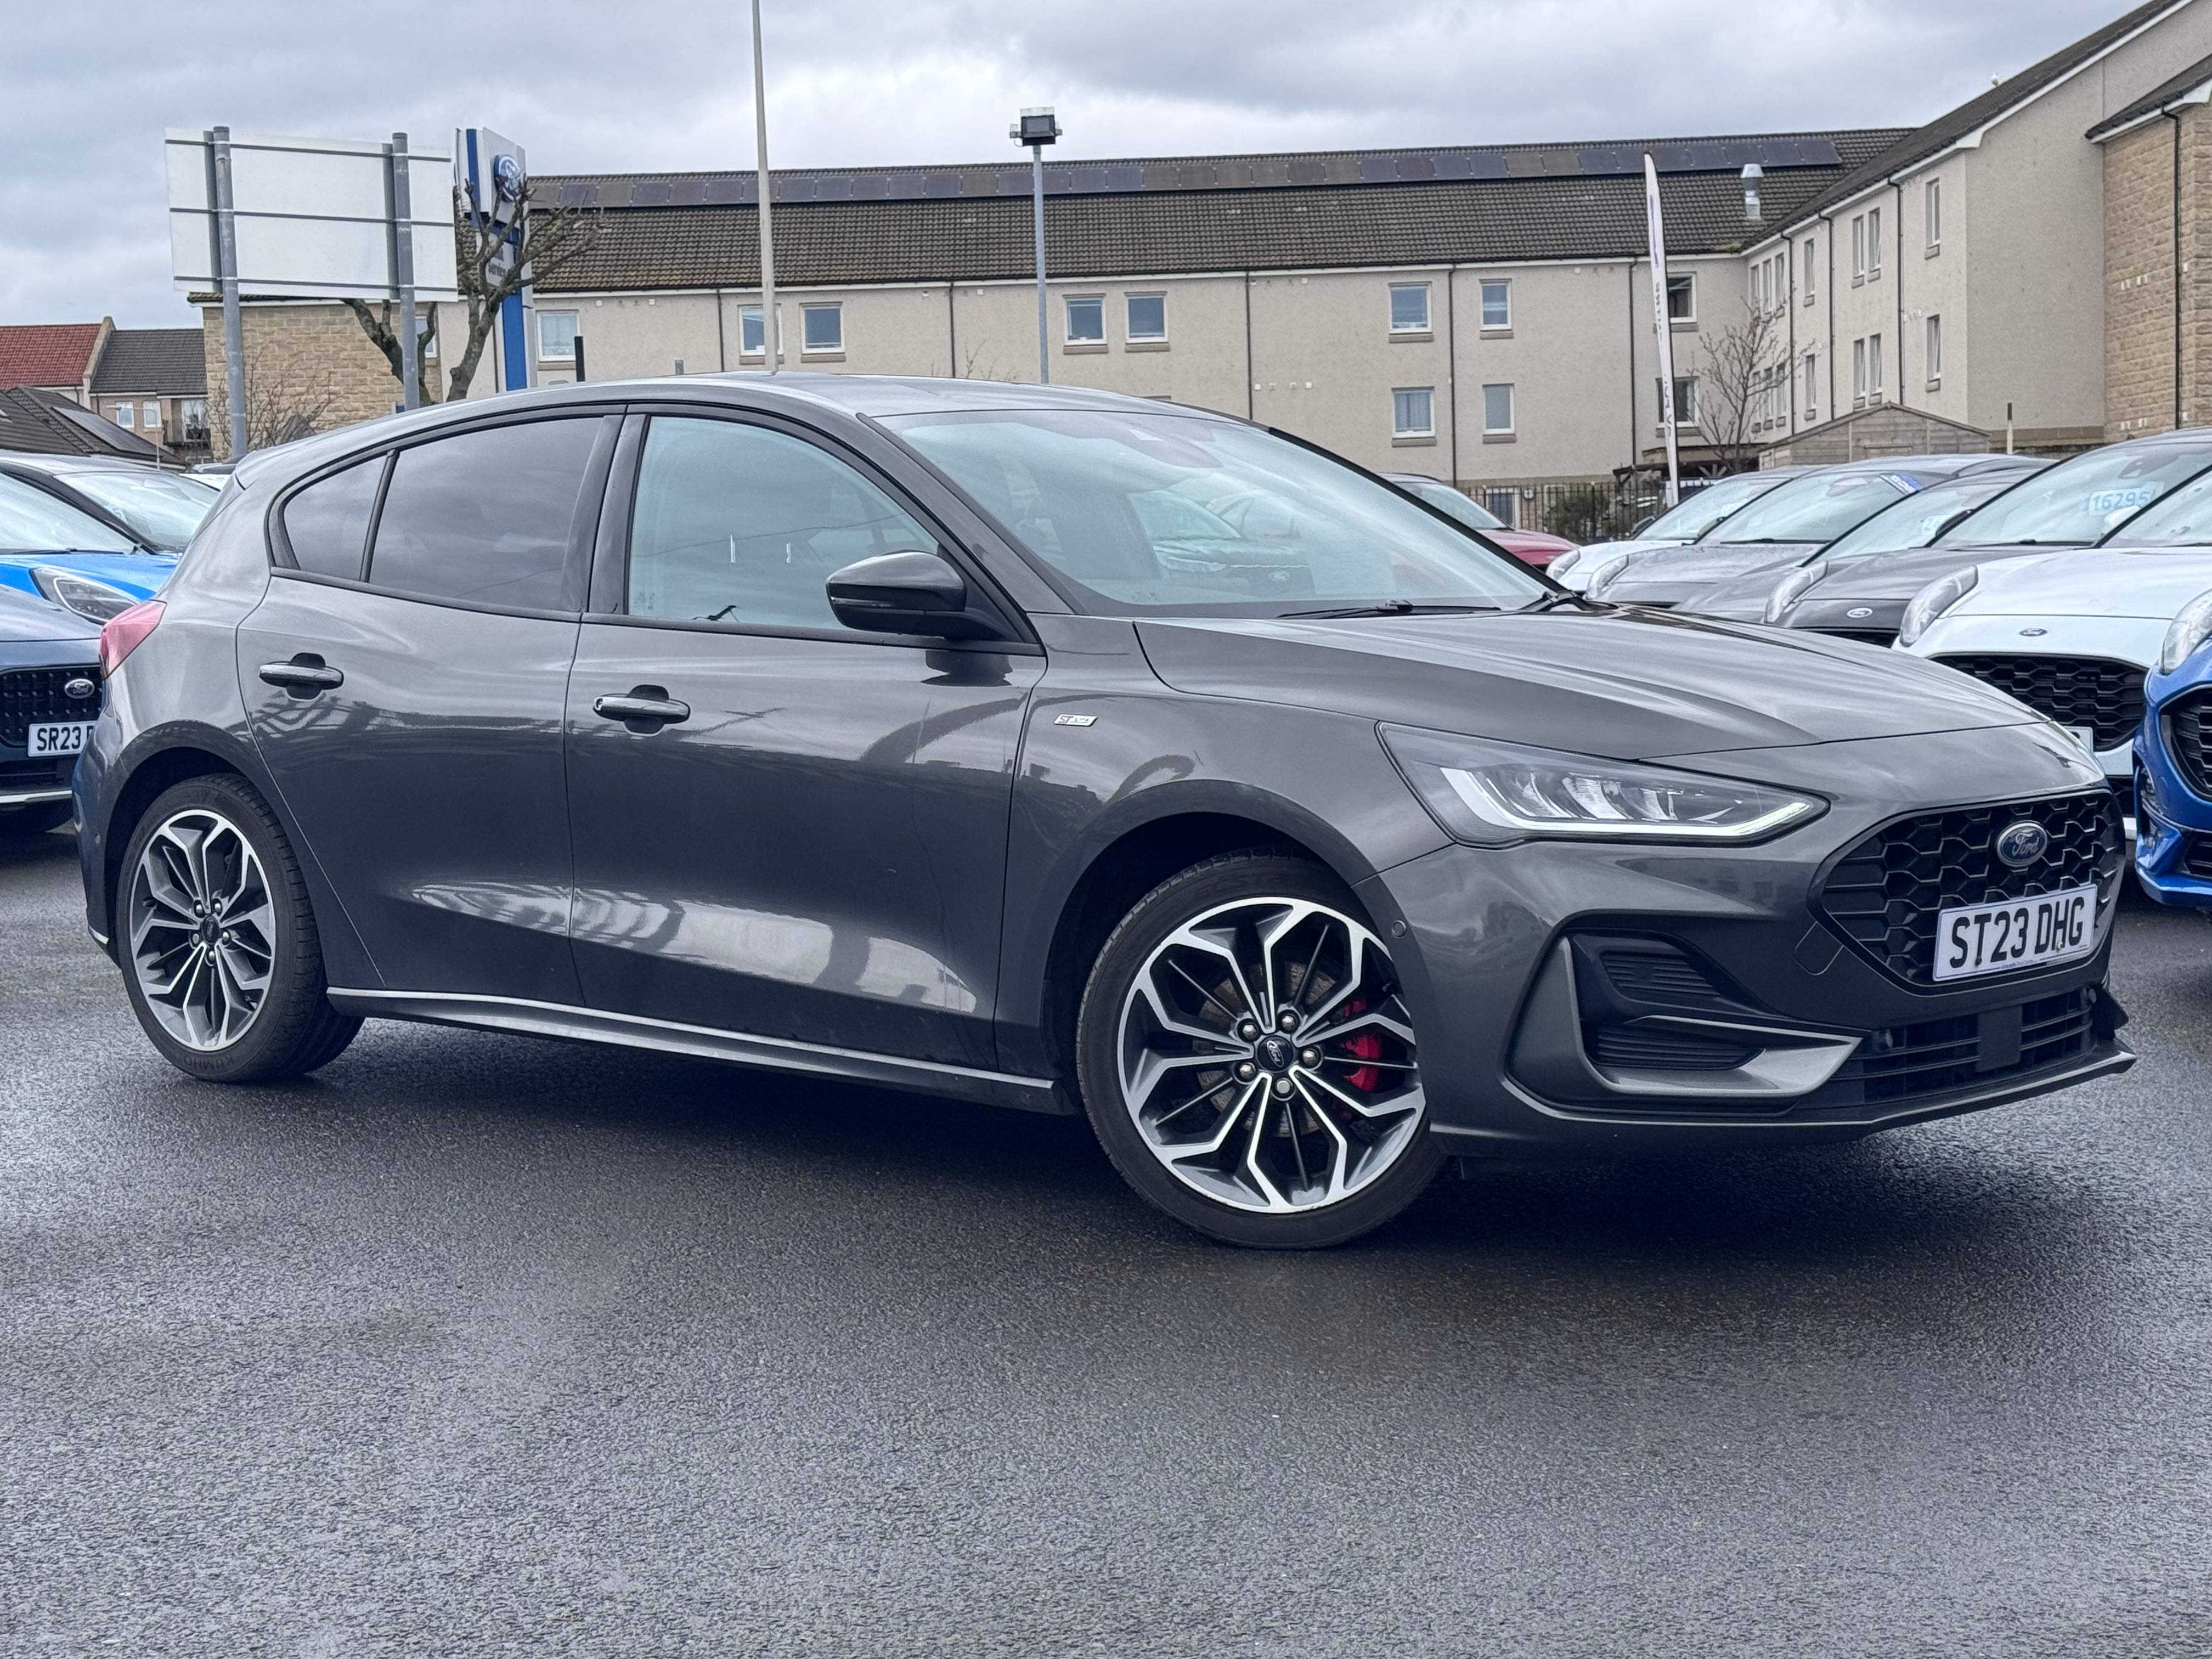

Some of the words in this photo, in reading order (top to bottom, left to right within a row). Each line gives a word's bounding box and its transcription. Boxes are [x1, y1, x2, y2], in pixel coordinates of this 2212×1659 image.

[37, 726, 81, 751] SR23
[2012, 832, 2039, 856] Ford
[1949, 907, 2029, 969] ST23
[2034, 896, 2085, 955] DHG
